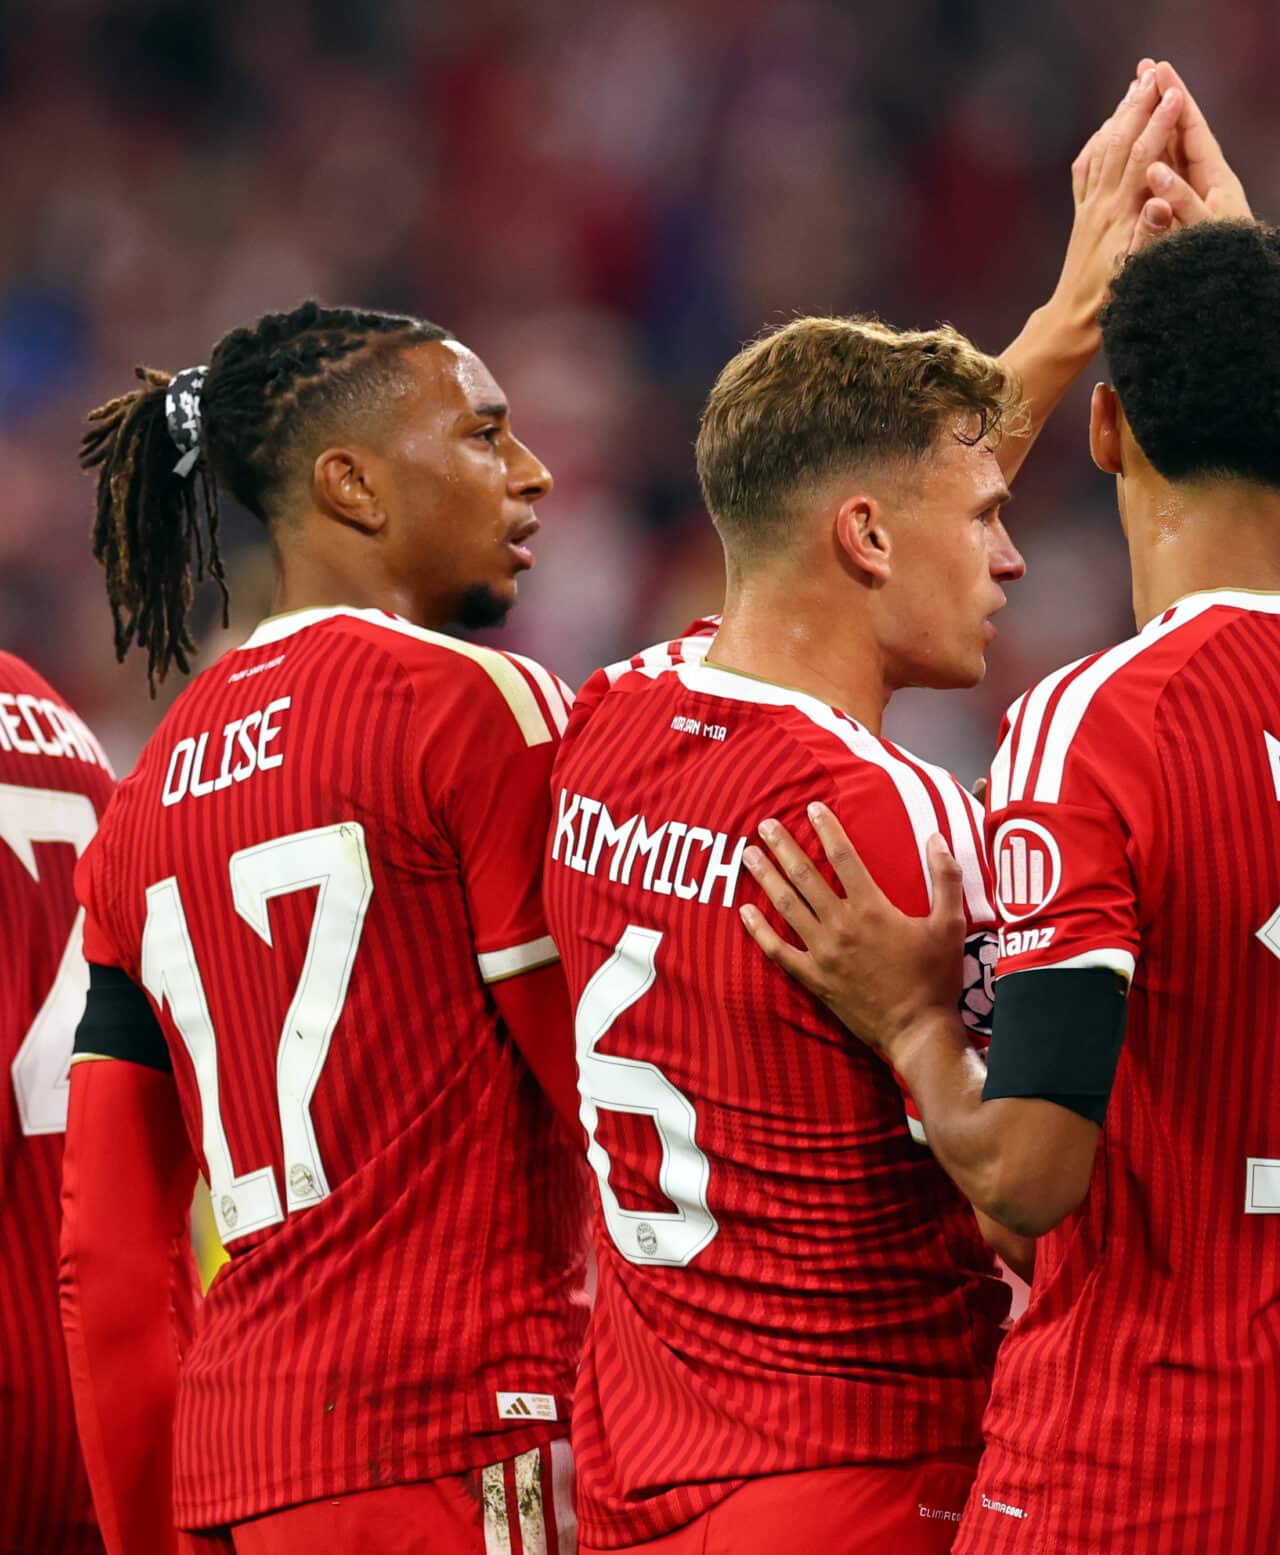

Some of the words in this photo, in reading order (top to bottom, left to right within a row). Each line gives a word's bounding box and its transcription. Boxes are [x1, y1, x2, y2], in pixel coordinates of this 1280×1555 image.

[161, 695, 292, 807] OLISE
[703, 723, 728, 742] MIA
[551, 787, 750, 907] KIMMICH
[998, 926, 1056, 958] ianz
[140, 820, 374, 1246] 17
[574, 924, 719, 1267] 6
